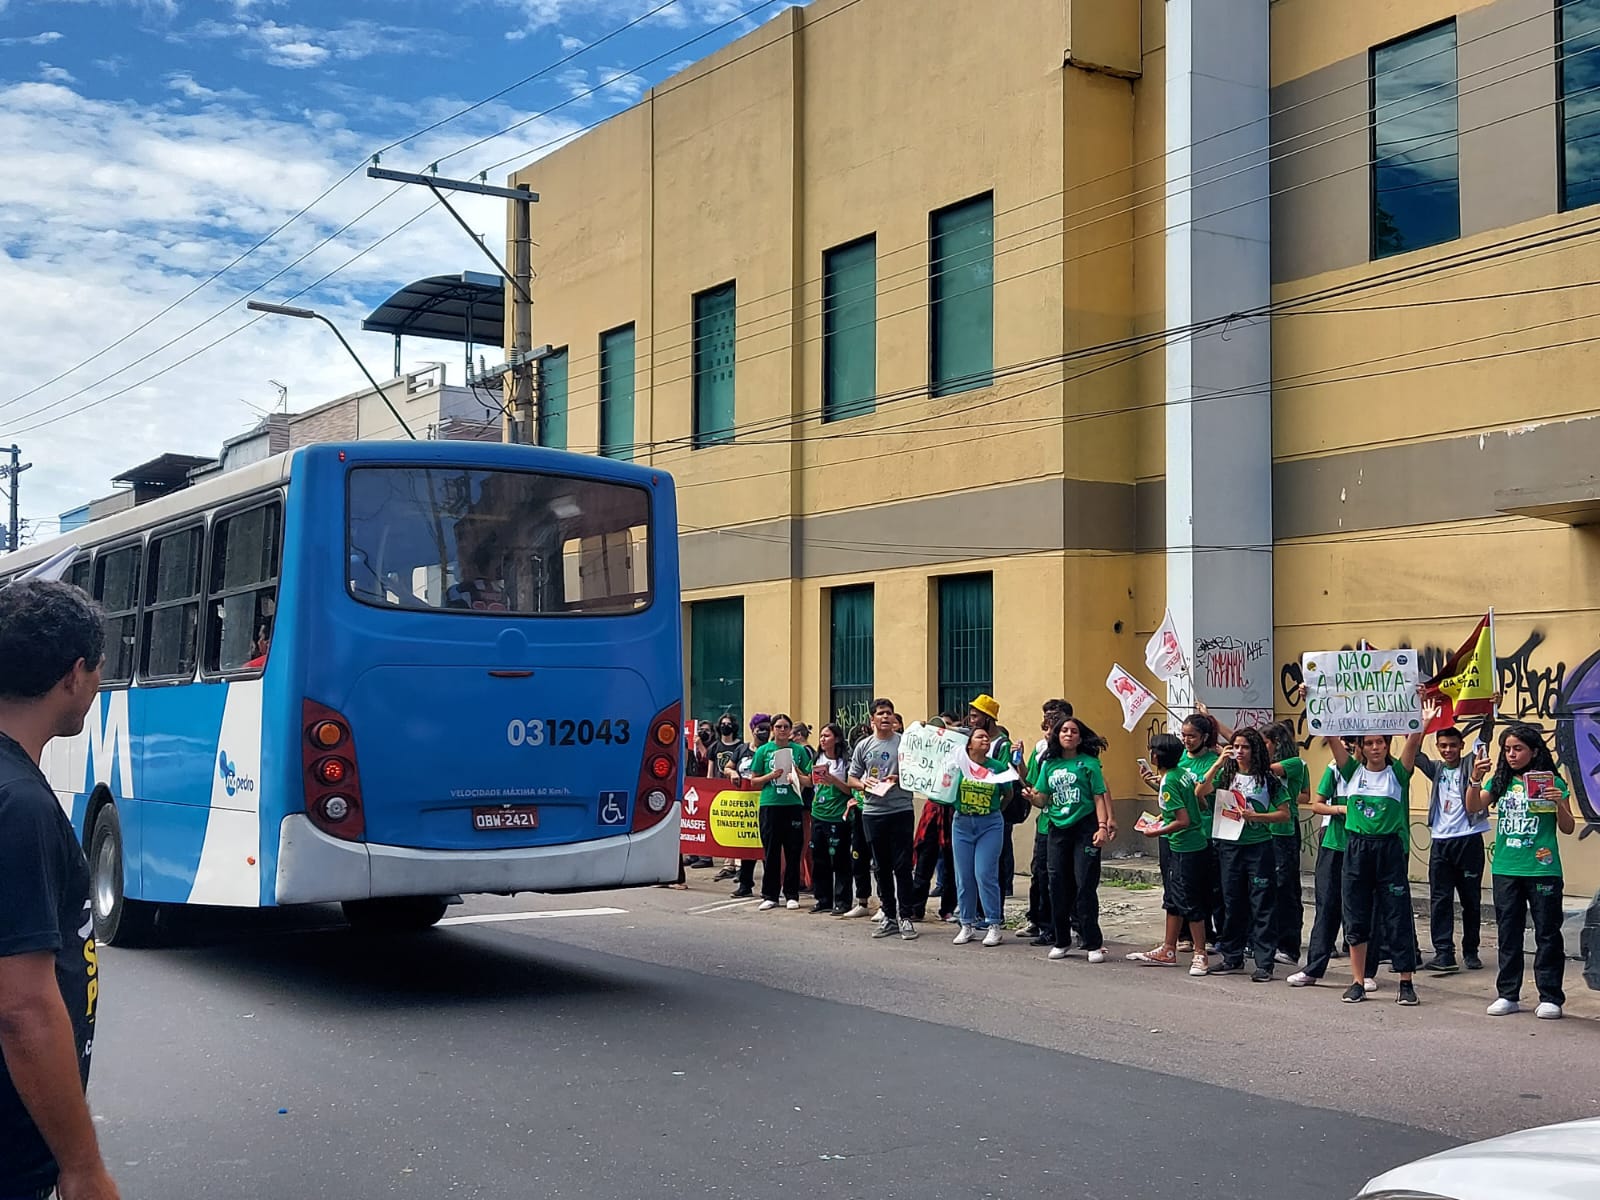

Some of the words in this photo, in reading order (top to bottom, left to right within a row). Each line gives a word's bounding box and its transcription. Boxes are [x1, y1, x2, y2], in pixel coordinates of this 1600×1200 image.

[1337, 652, 1371, 671] NÃO
[507, 718, 631, 746] 0312043
[236, 774, 254, 794] pedro
[901, 768, 941, 793] FEDERAL
[450, 788, 500, 797] VELOCIDADE
[503, 787, 535, 796] MÁXIMA
[716, 820, 745, 828] SINASEFE
